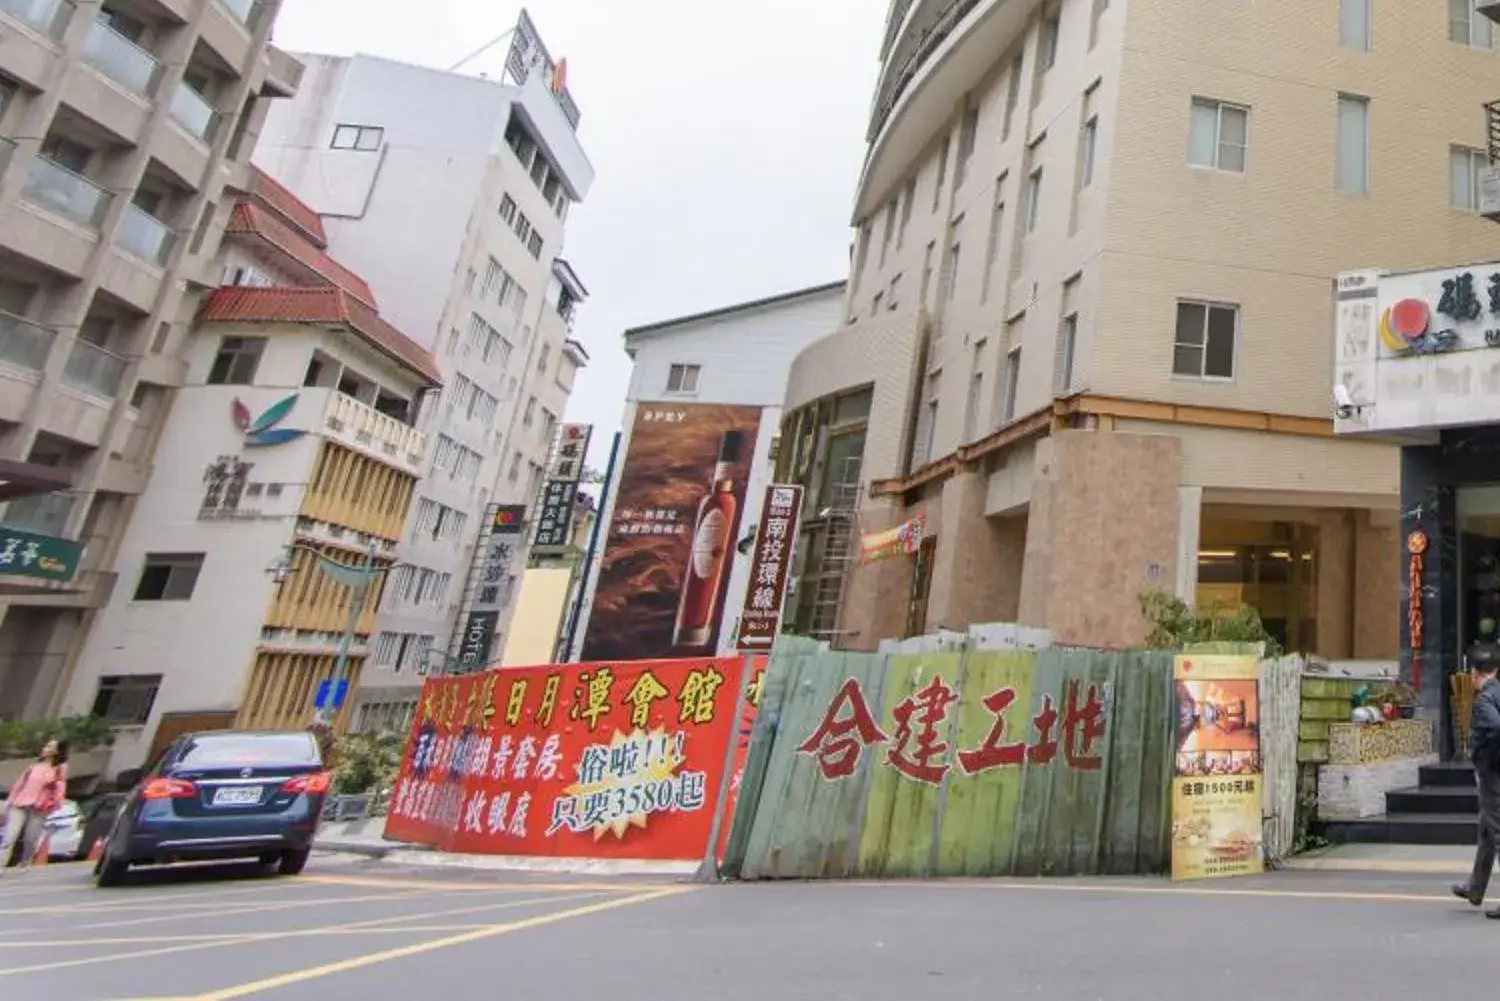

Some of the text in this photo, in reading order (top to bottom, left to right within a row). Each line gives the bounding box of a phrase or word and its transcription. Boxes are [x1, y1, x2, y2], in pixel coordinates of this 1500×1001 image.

[752, 517, 789, 609] 南投環線
[800, 674, 1107, 789] 合建工地
[545, 770, 707, 837] 只要3580起
